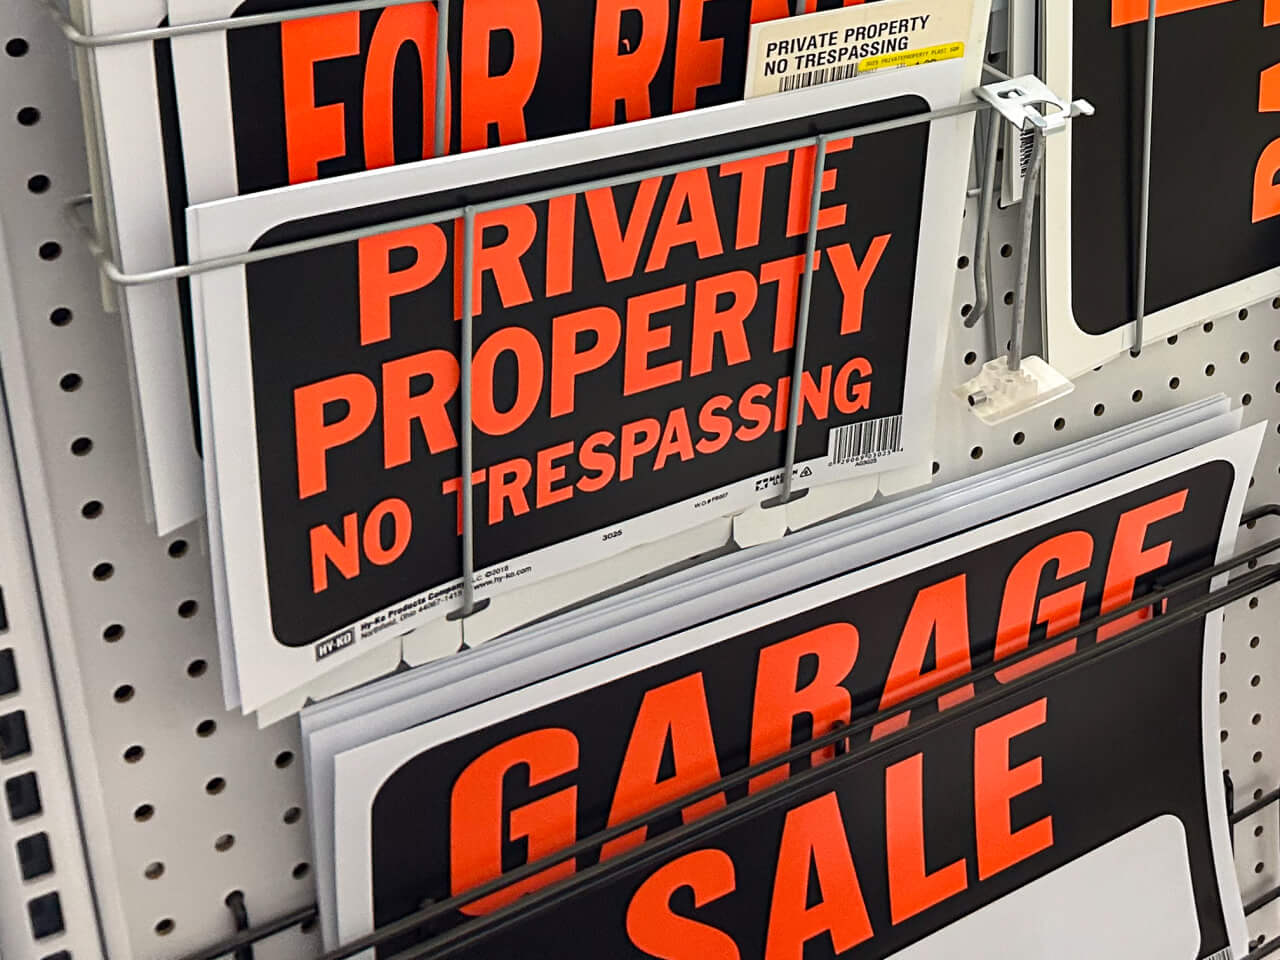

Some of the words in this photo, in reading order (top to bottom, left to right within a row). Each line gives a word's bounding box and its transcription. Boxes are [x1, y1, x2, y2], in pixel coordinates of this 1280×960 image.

[764, 58, 787, 76] NO
[795, 36, 909, 70] TRESPASSING
[766, 31, 838, 57] PRIVATE
[844, 15, 930, 43] PROPERTY
[357, 138, 853, 346] PRIVATE
[294, 233, 892, 500] PROPERTY
[310, 499, 413, 595] NO
[442, 356, 874, 537] TRESPASSING
[317, 630, 354, 657] HY-KO
[388, 597, 427, 618] Products
[448, 488, 1187, 917] GARAGE
[625, 698, 1054, 960] SALE
